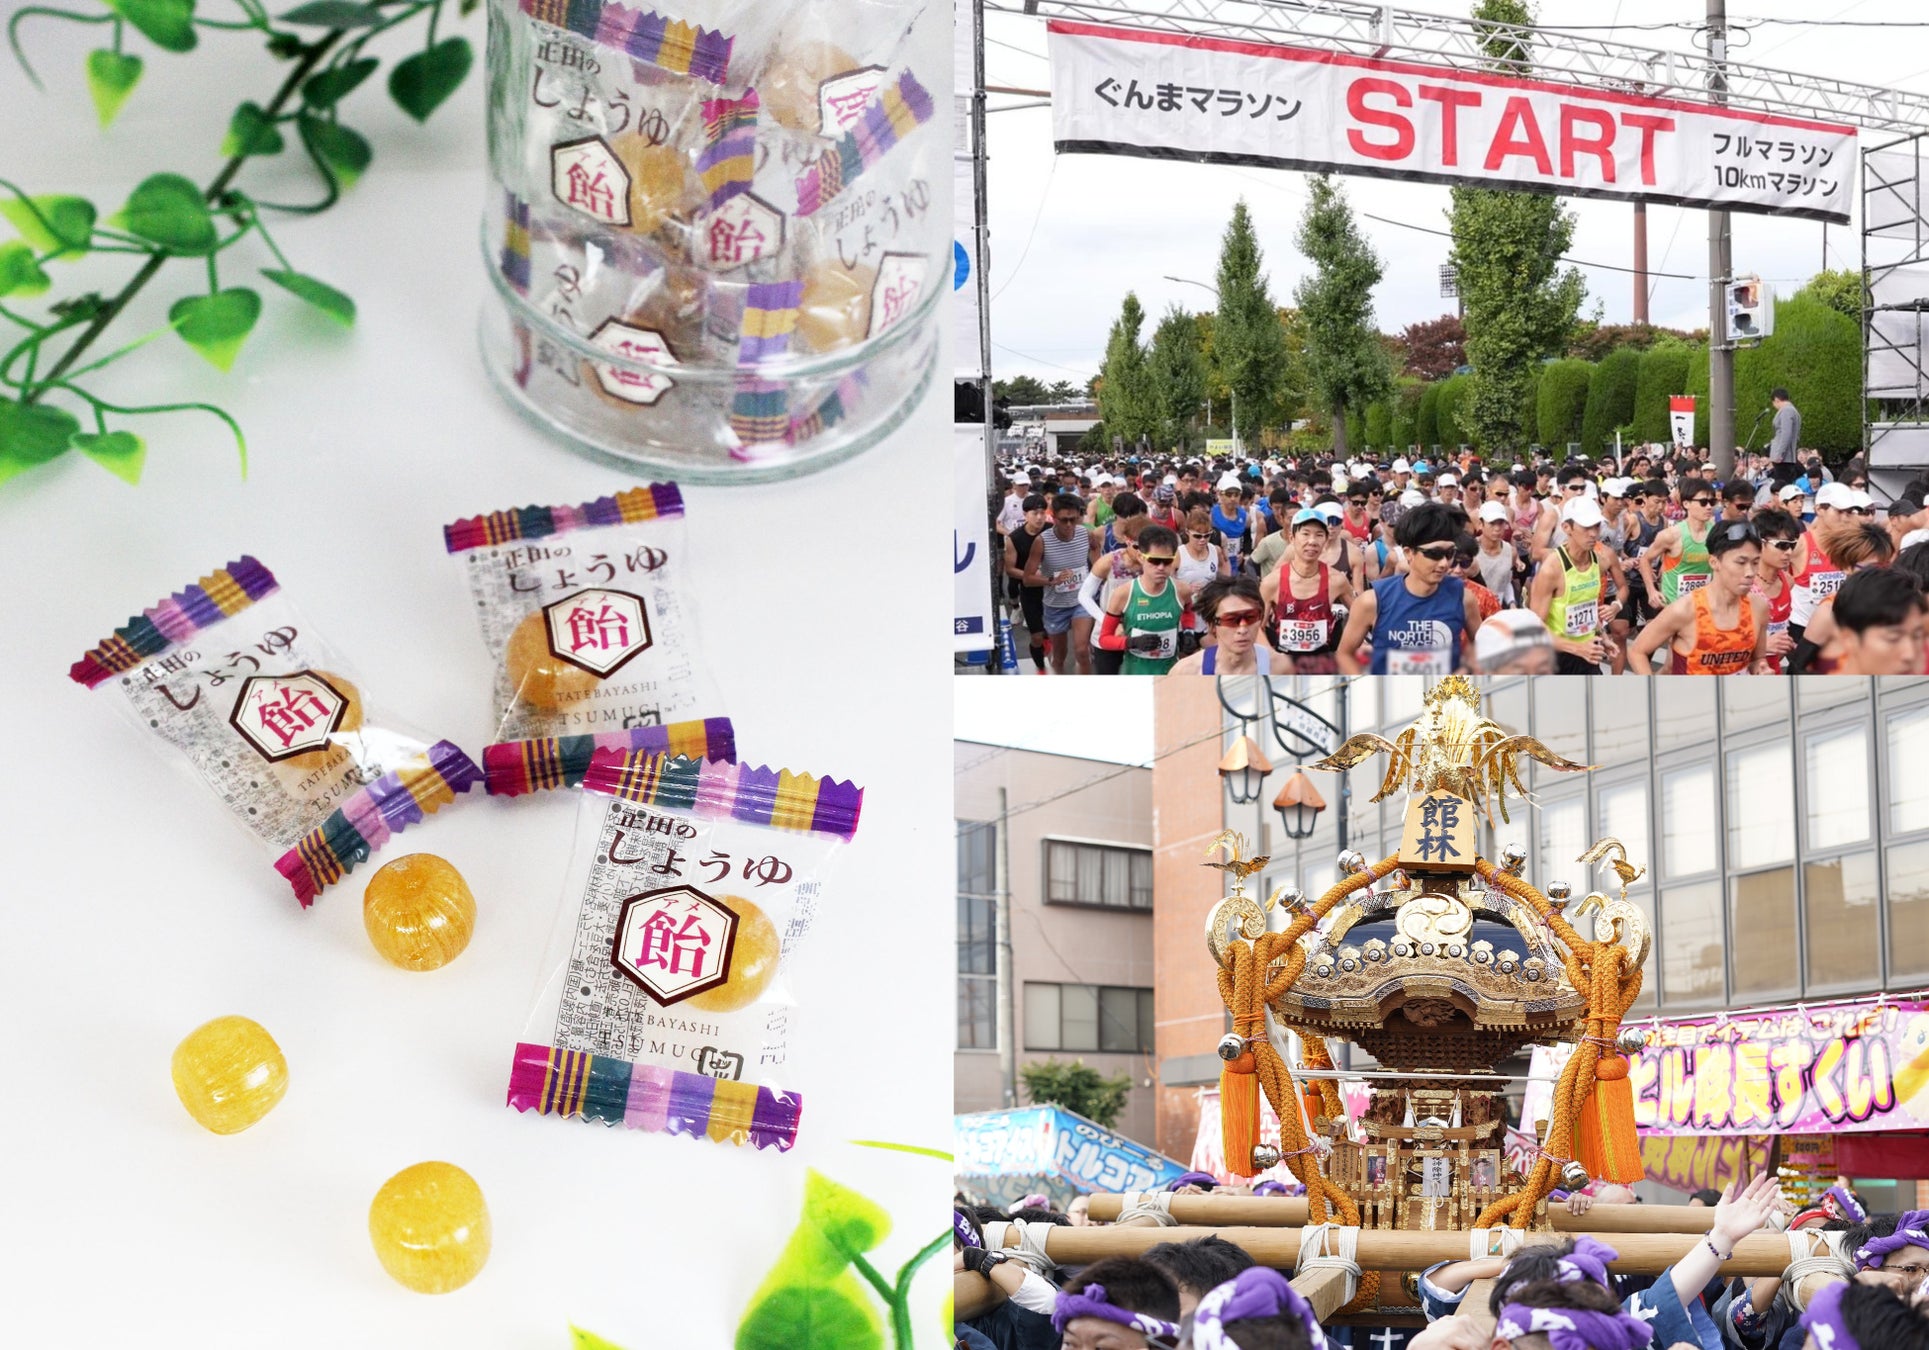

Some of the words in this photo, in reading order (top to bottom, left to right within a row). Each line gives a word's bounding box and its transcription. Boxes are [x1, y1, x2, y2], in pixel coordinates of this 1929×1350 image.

[537, 41, 601, 75] 正田の
[533, 64, 670, 148] しょうゆ
[1095, 77, 1302, 121] ぐんまマラソン
[1346, 76, 1676, 186] START
[1713, 133, 1834, 168] フルマラソン
[567, 162, 615, 219] 飴
[1713, 164, 1838, 198] 10kmマラソン
[710, 217, 766, 264] 飴
[504, 545, 573, 570] 正田の
[509, 545, 669, 593] しょうゆ
[1819, 579, 1845, 594] 251
[564, 604, 630, 654] 飴
[1136, 611, 1173, 621] ETHIOPIA
[1407, 620, 1432, 631] THE
[1574, 609, 1594, 626] 1271
[1289, 628, 1320, 642] 3956
[1388, 630, 1432, 641] NORTH
[153, 626, 298, 711] しょうゆ
[1700, 650, 1750, 666] UNITED
[556, 680, 658, 702] TATEBAYASHI
[258, 685, 332, 748] 飴
[616, 813, 698, 840] 正田の
[1414, 794, 1463, 863] 館林
[608, 829, 793, 888] しょうゆ
[635, 909, 712, 979] 飴
